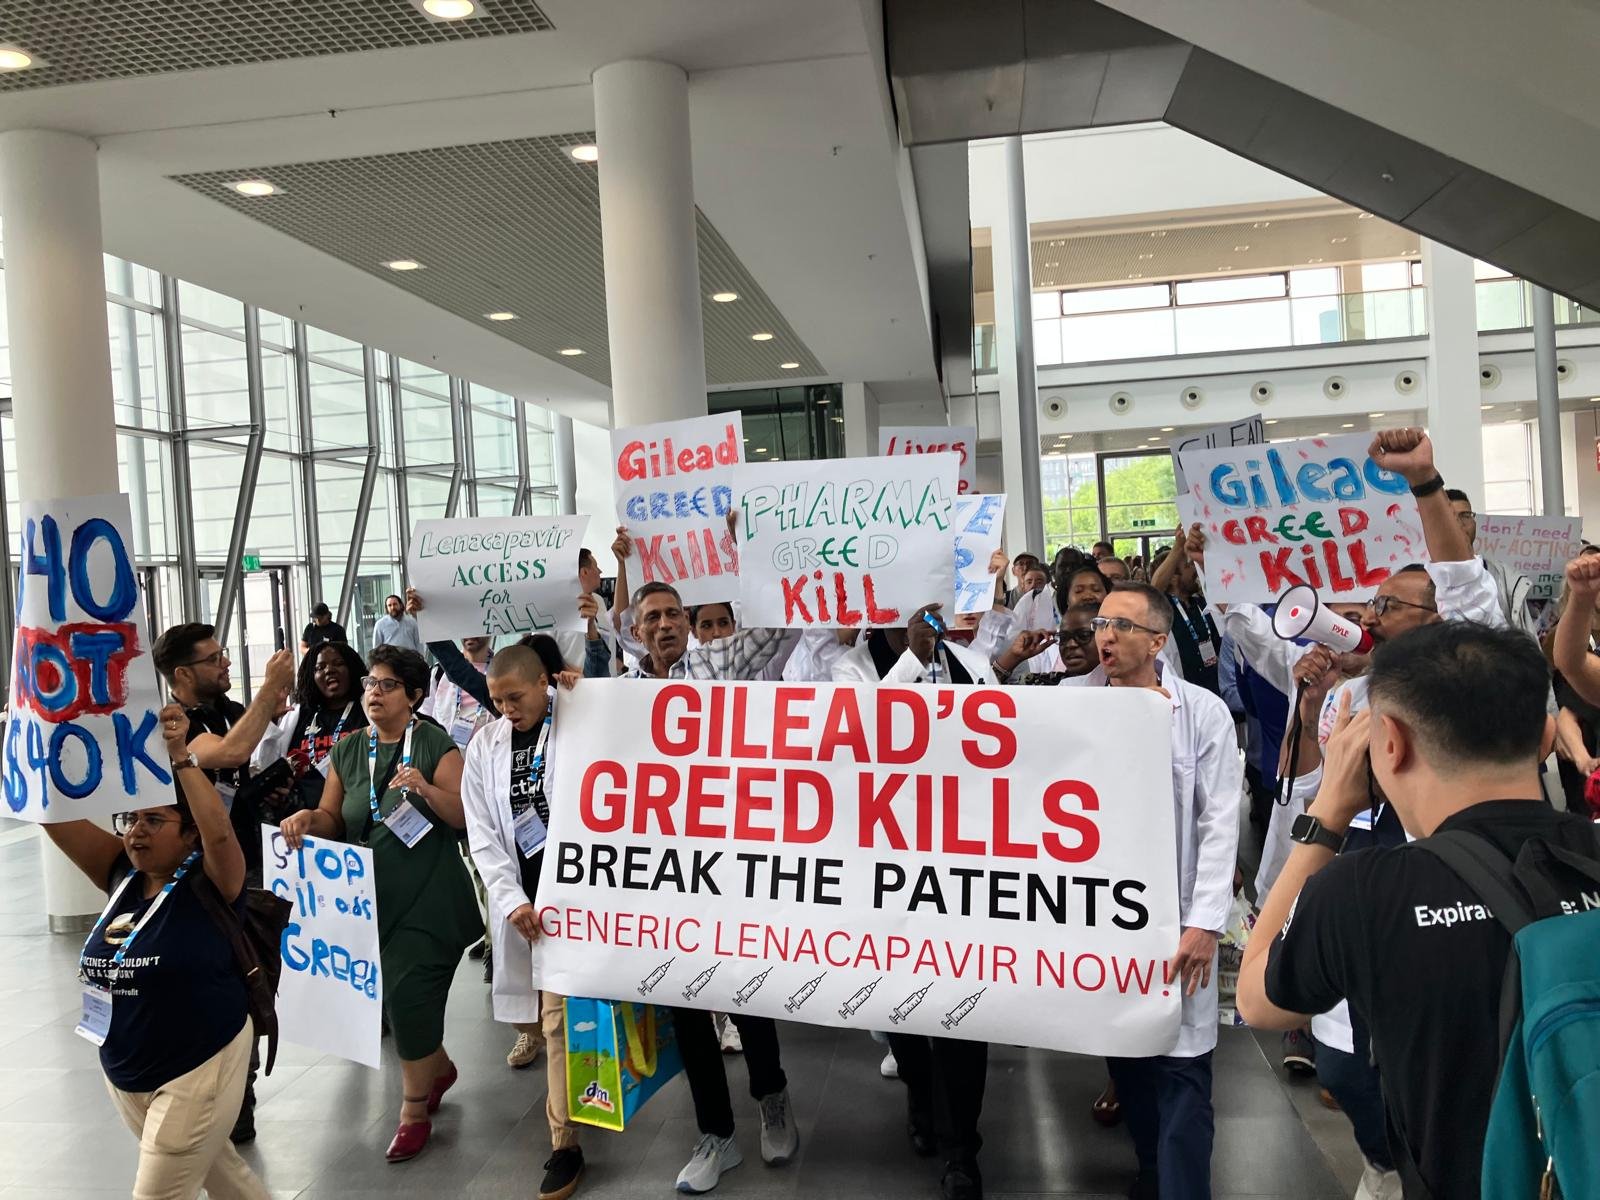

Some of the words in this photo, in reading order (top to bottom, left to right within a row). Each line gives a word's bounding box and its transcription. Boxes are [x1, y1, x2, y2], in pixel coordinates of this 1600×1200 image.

[616, 423, 739, 482] Gilead
[742, 477, 952, 541] PHARMA
[1532, 523, 1572, 540] need
[16, 513, 137, 624] 40
[420, 524, 573, 559] Lenacapavir
[452, 558, 547, 587] ACCESS
[479, 589, 511, 607] for
[483, 602, 557, 634] ALL
[17, 632, 125, 711] NOT
[651, 684, 1017, 769] GILEAD'S
[3, 709, 172, 812] $40K
[580, 760, 834, 843] GREED
[858, 772, 1100, 863] KILLS
[556, 842, 724, 895] BREAK
[737, 852, 843, 905] THE
[873, 862, 1149, 930] PATENTS
[1414, 901, 1494, 927] Expira
[109, 955, 160, 968] SOULDN'T
[538, 906, 700, 952] GENERIC
[714, 921, 1018, 984] LENACAPAVIR
[1036, 950, 1170, 997] NOW!
